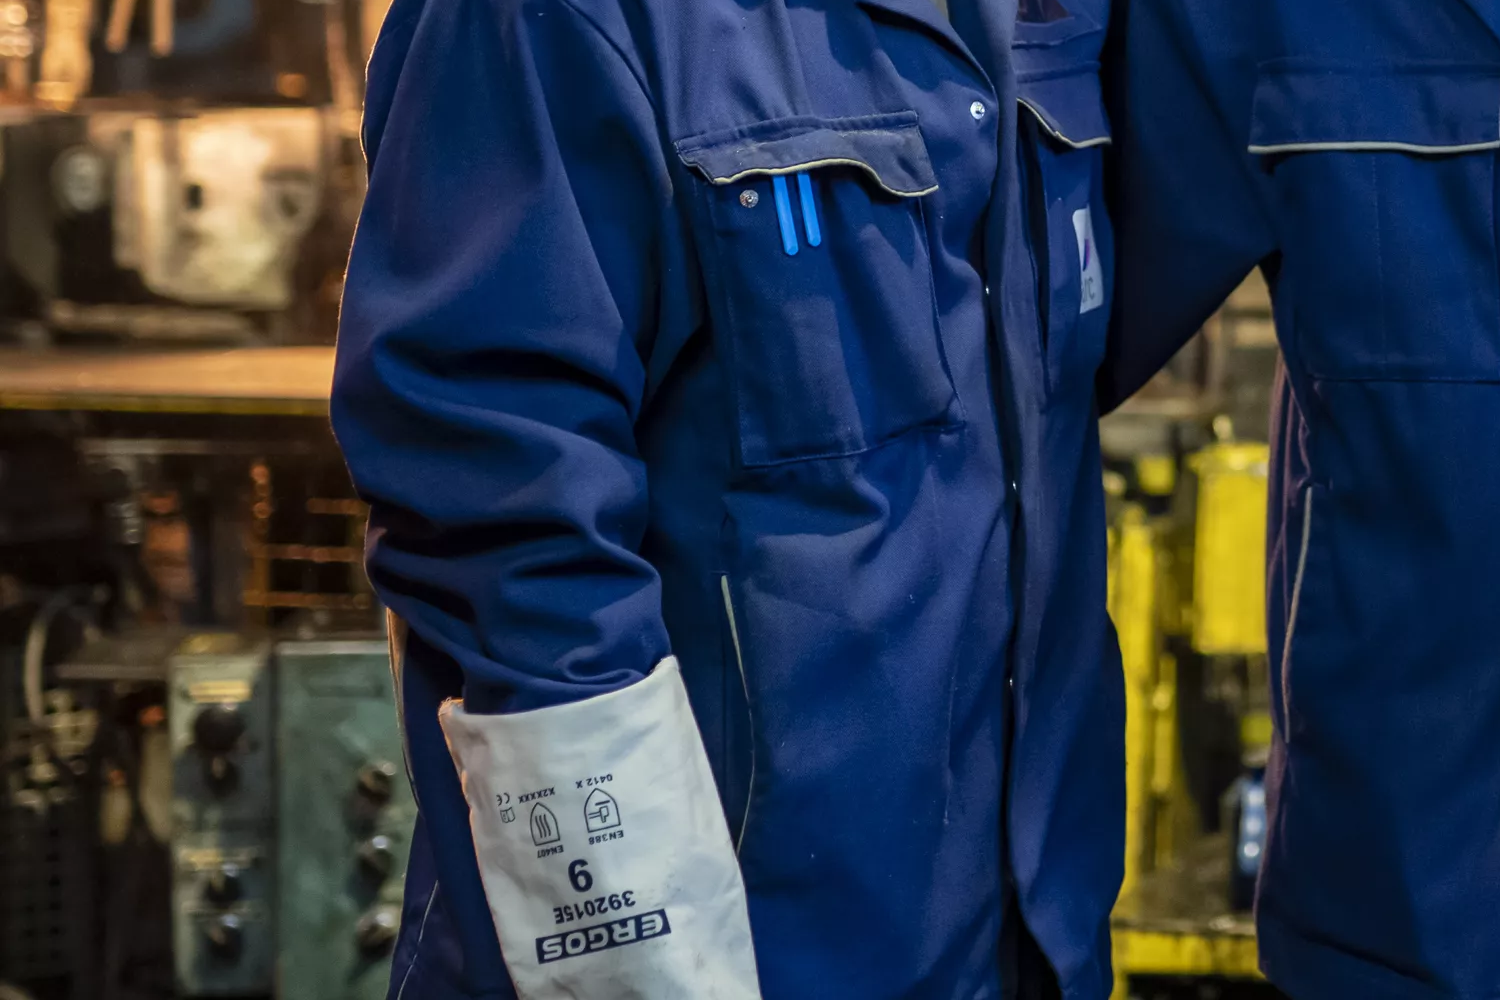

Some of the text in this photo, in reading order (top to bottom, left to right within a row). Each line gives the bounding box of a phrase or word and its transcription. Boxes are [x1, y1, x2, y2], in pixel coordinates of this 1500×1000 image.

[586, 773, 613, 787] 0412
[588, 830, 625, 845] EN388
[537, 845, 565, 858] EN407
[567, 859, 593, 893] 9
[553, 890, 636, 924] 392015E
[541, 910, 665, 961] ERGOS
